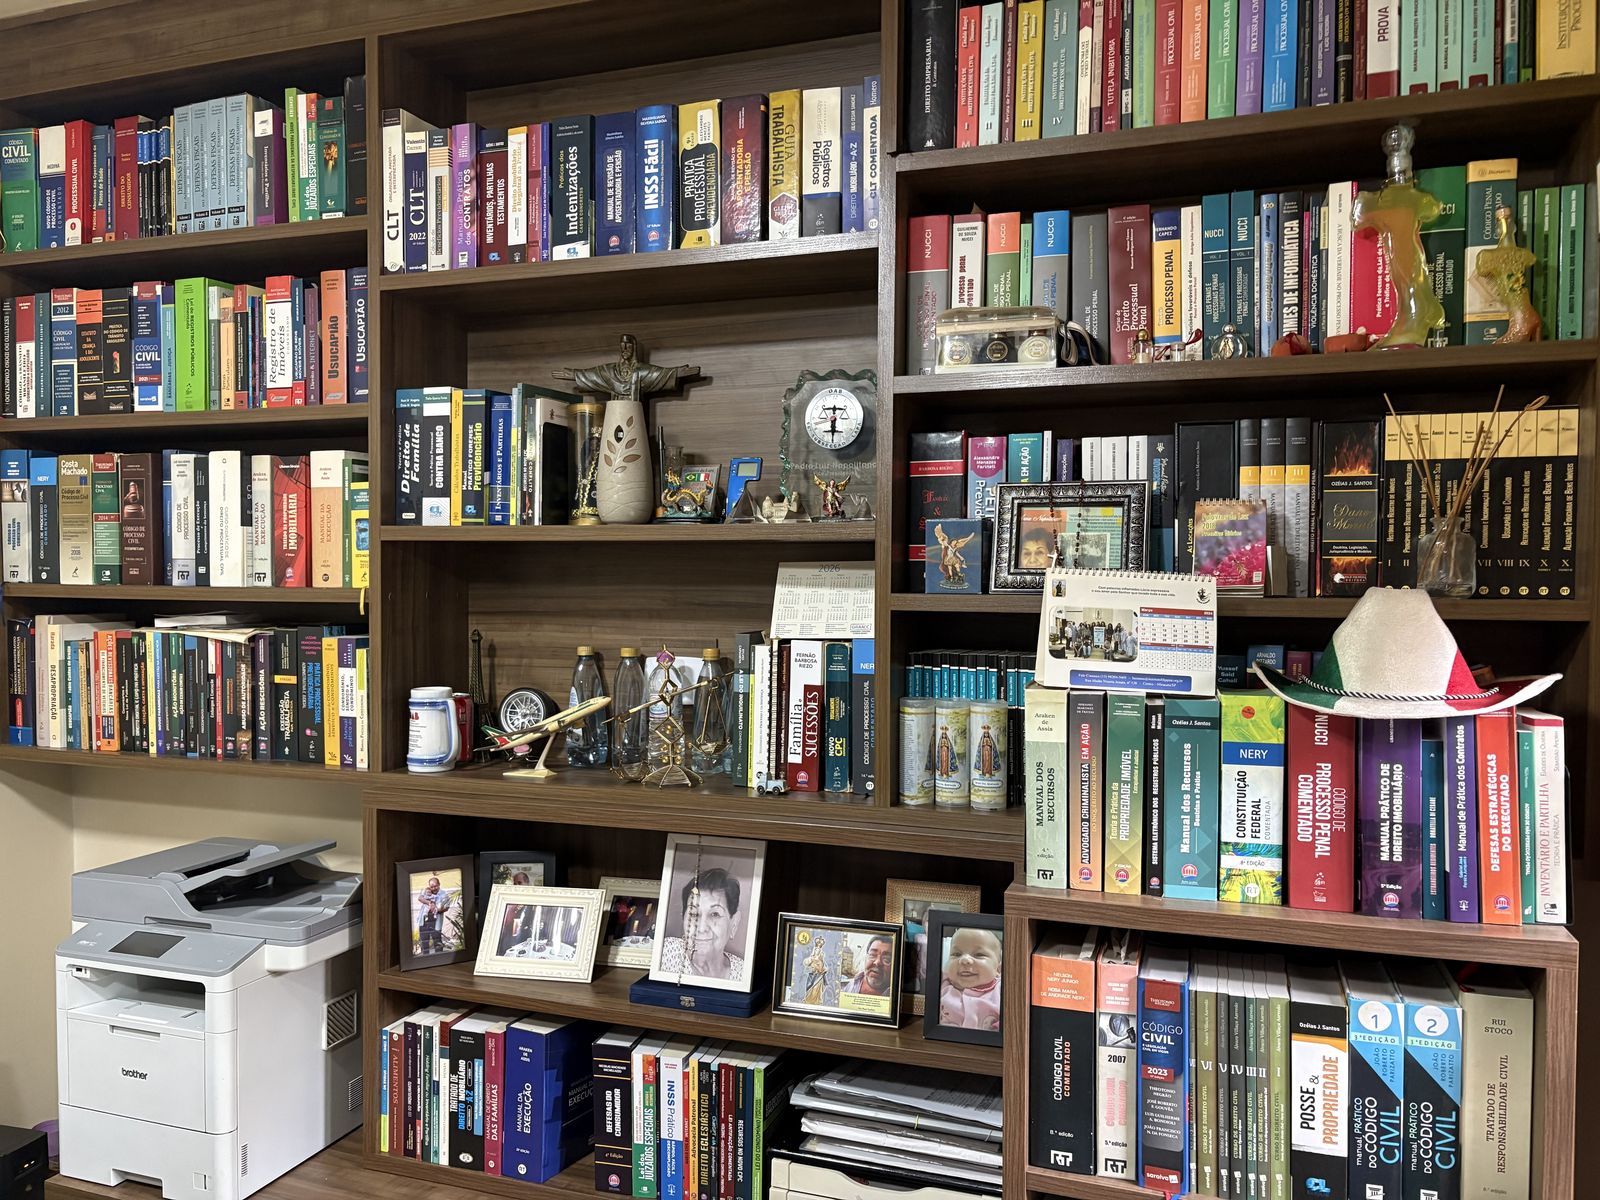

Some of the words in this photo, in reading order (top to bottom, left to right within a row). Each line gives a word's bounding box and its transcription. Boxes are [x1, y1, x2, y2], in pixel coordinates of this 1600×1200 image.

[1378, 6, 1389, 42] PROVA
[1107, 39, 1115, 76] INIBITÓRIA
[2, 147, 31, 157] CIVIL
[645, 139, 658, 173] Fácil
[773, 105, 784, 185] TRABALHISTA
[785, 124, 794, 160] GUIA
[684, 159, 695, 198] PRÁTICA
[812, 141, 822, 184] Públicos
[821, 140, 832, 187] Registros
[309, 179, 317, 210] JUIZADOS
[566, 146, 580, 235] Indenizações
[645, 177, 658, 209] INSS
[695, 154, 705, 220] PROCESSUAL
[410, 189, 424, 225] CLT
[486, 200, 494, 243] INVENTÁRIOS,
[387, 210, 399, 241] CLT
[1238, 217, 1248, 241] NUCCI
[1165, 250, 1173, 278] PENAL
[1282, 220, 1298, 289] INFORMÁTICA
[1165, 280, 1174, 325] PROCESSO
[1283, 291, 1298, 304] DE
[269, 308, 276, 324] de
[355, 299, 365, 362] USUCAPIÃO
[1122, 301, 1130, 331] Direito
[136, 352, 160, 361] CIVIL
[269, 327, 278, 383] Registro
[327, 315, 338, 379] USUCAPIÃO
[404, 424, 410, 437] de
[401, 440, 410, 493] Direito
[411, 424, 420, 482] Família
[474, 423, 482, 490] Previdenciário
[1020, 447, 1030, 464] AÇÃO
[1021, 467, 1028, 476] EM
[1503, 477, 1512, 505] CONDOMÍNIO
[287, 493, 297, 550] IMOBILIÁRIA
[1502, 514, 1511, 538] USUCAPIÃO
[818, 564, 840, 573] 2026
[790, 703, 802, 756] Família
[804, 691, 818, 757] SUCESSÕES
[1081, 724, 1090, 745] AÇÃO
[1082, 747, 1089, 759] EM
[1240, 749, 1268, 760] NERY
[1455, 725, 1464, 764] Contratos
[1120, 749, 1132, 781] IMÓVEL
[1181, 743, 1191, 791] Recursos
[1380, 764, 1390, 776] DE
[1456, 766, 1465, 780] dos
[1181, 794, 1191, 812] dos
[1236, 770, 1249, 838] CONSTITUIÇÃO
[1315, 762, 1331, 820] PROCESSO
[1378, 778, 1390, 818] PRÁTICO
[1391, 764, 1403, 823] IMOBILIÁRIO
[1457, 782, 1465, 809] Prática
[1487, 754, 1498, 826] ESTRATÉGICAS
[1500, 774, 1511, 834] EXECUTADO
[1538, 783, 1550, 828] PARTILHA
[1120, 783, 1131, 840] PROPRIEDADE
[1251, 798, 1261, 839] FEDERAL
[1297, 774, 1313, 843] COMENTADO
[1458, 811, 1466, 821] de
[1180, 816, 1191, 853] Manual
[1315, 822, 1330, 858] PENAL
[1380, 821, 1390, 860] MANUAL
[1393, 825, 1403, 861] DIREITO
[1458, 823, 1467, 851] Manual
[1490, 828, 1500, 871] DEFESAS
[1503, 837, 1512, 852] DO
[1538, 840, 1550, 896] INVENTÁRIO
[1142, 1022, 1183, 1035] CÓDIGO
[1142, 1032, 1174, 1045] CIVIL
[1484, 1026, 1512, 1035] STOCO
[1053, 1036, 1063, 1060] CIVIL
[1108, 1054, 1126, 1064] 2007
[122, 1067, 148, 1080] brother
[1052, 1063, 1063, 1100] CÓDIGO
[1148, 1067, 1168, 1076] 2023
[1309, 1075, 1318, 1084] &
[1499, 1055, 1508, 1080] CIVIL
[517, 1093, 522, 1102] DA
[523, 1083, 532, 1133] EXECUÇÃO
[606, 1090, 612, 1101] DO
[1300, 1086, 1315, 1130] POSSE
[1322, 1056, 1338, 1145] PROPRIEDADE
[1487, 1084, 1495, 1096] DE
[698, 1094, 709, 1151] ECLESIÁSTICO
[1354, 1098, 1362, 1133] PRÁTICO
[1363, 1097, 1377, 1153] CÓDIGO
[1486, 1098, 1495, 1142] TRATADO
[1497, 1082, 1507, 1173] RESPONSABILIDADE
[1380, 1106, 1400, 1164] CIVIL
[699, 1154, 708, 1185] DIREITO
[1146, 1172, 1169, 1182] saraiva
[1368, 1154, 1377, 1168] DO
